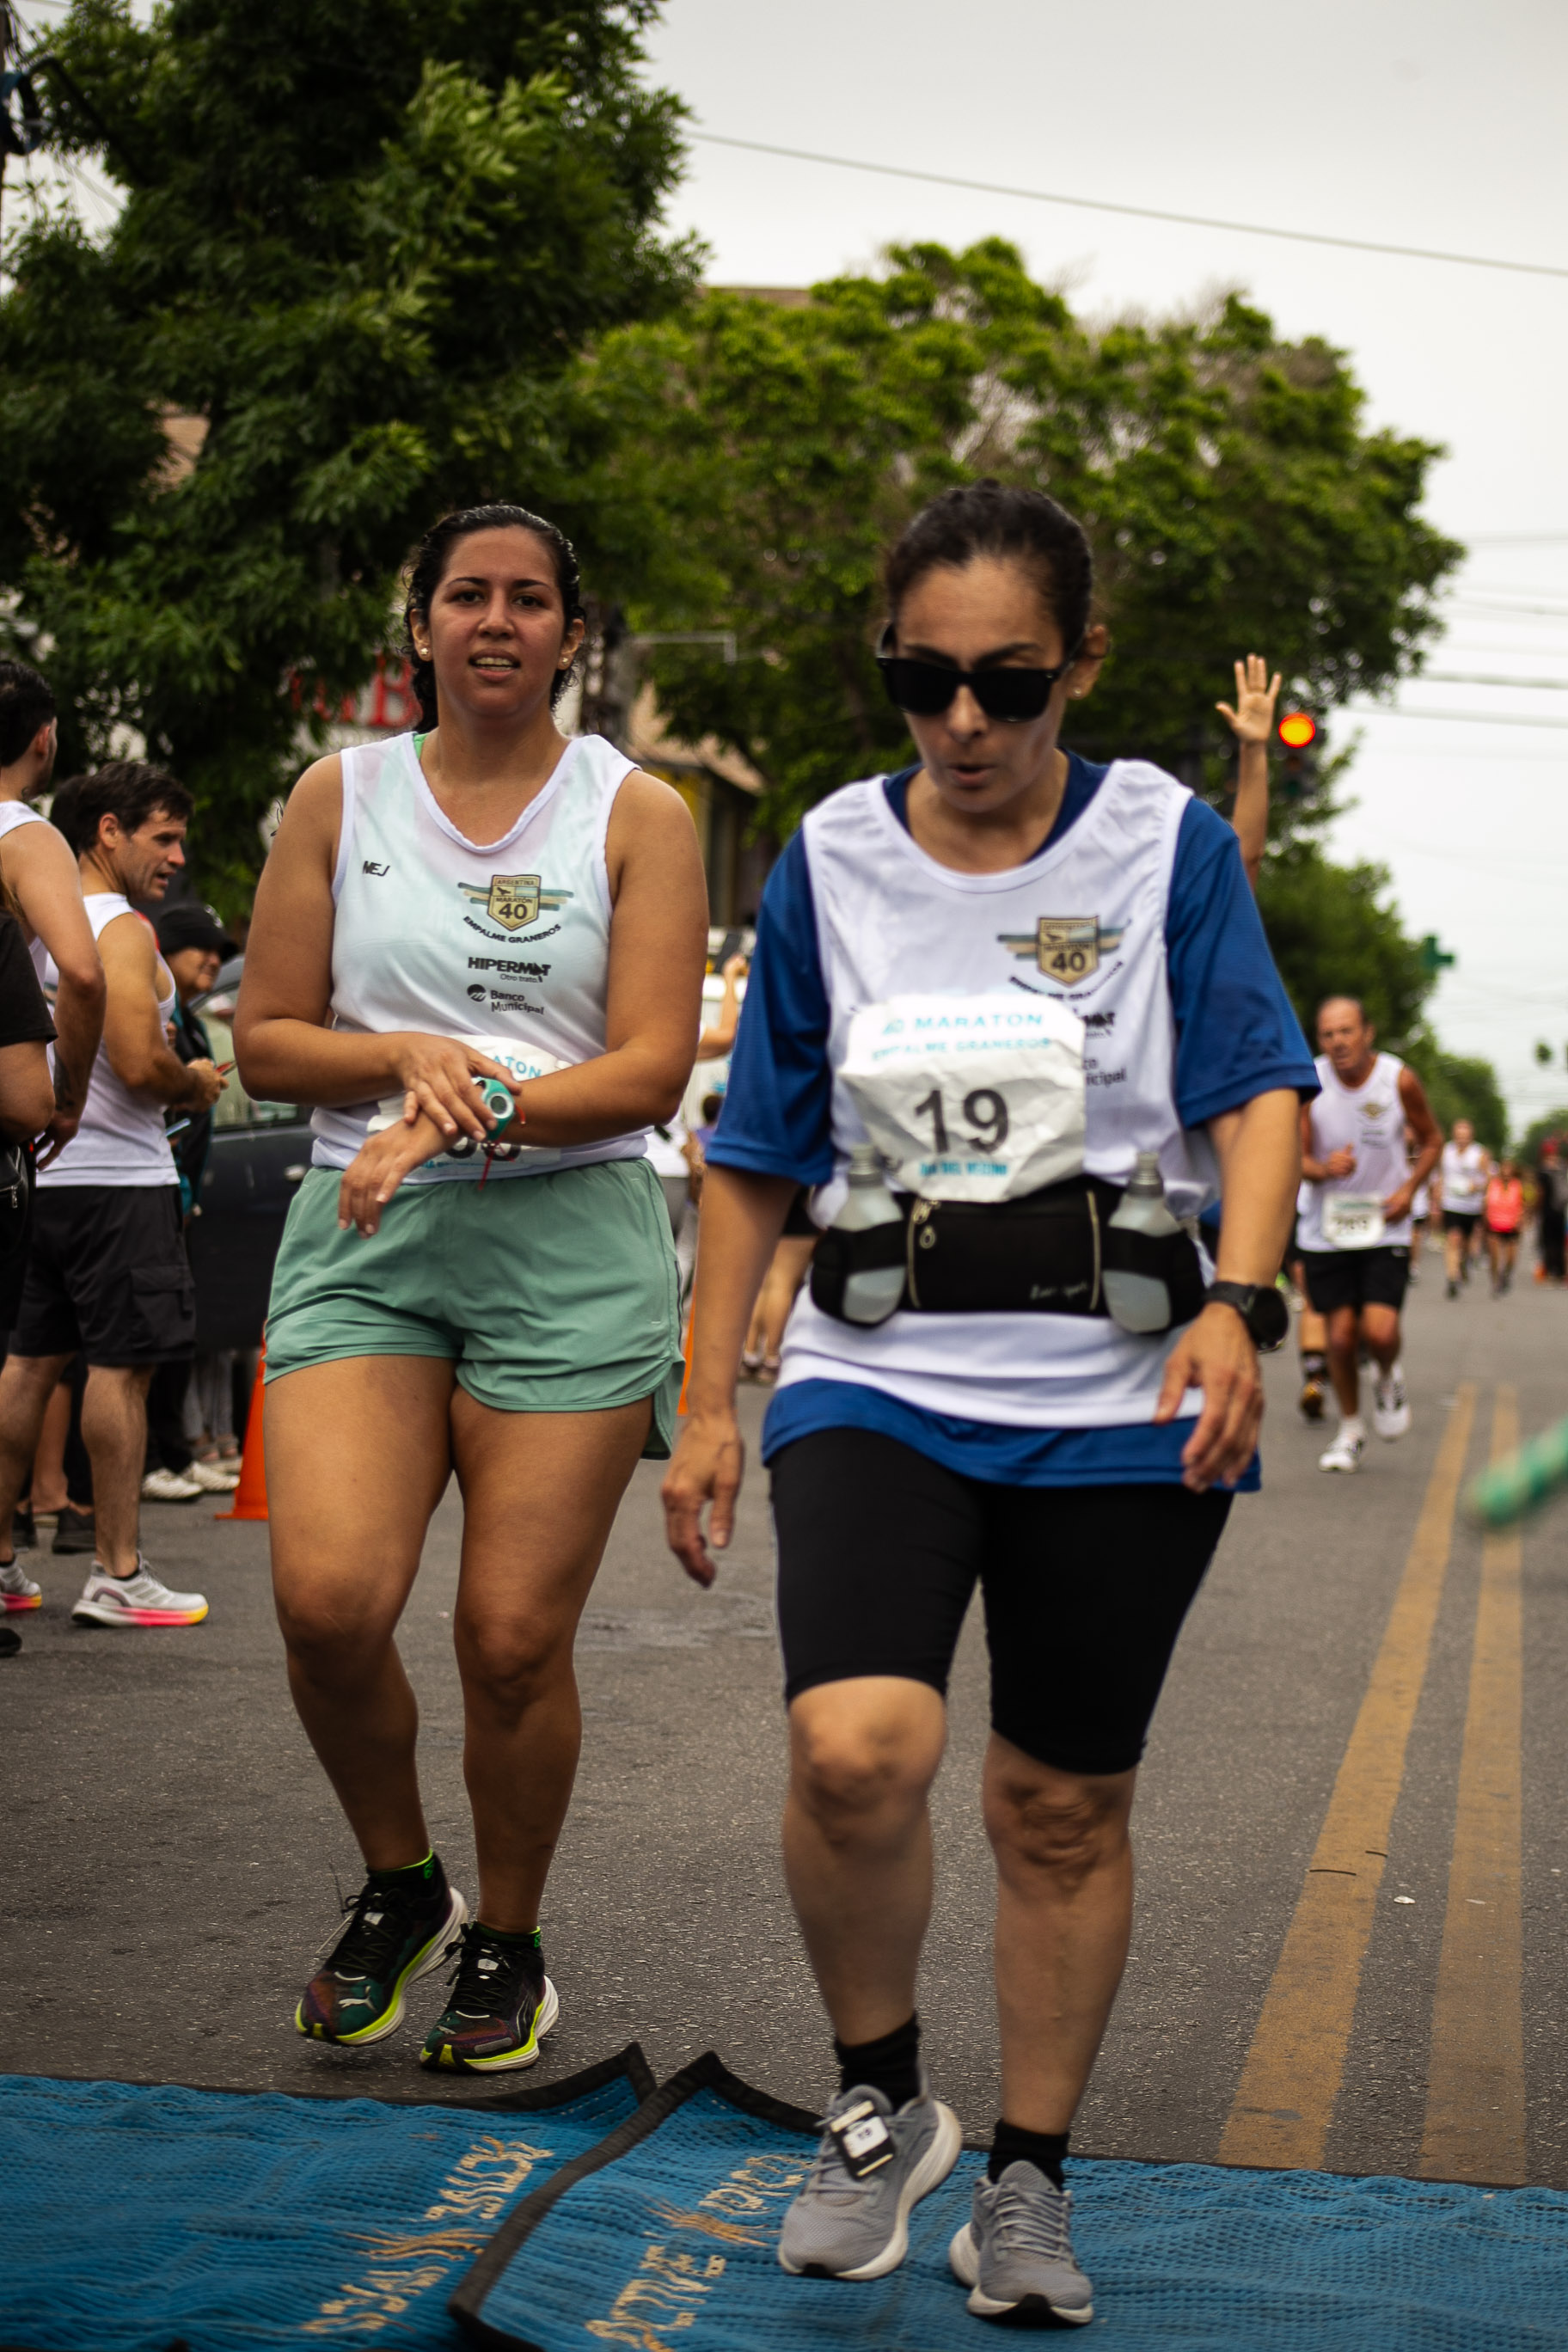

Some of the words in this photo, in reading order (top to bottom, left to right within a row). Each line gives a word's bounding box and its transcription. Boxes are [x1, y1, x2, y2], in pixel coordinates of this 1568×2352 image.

[498, 903, 528, 920] 40
[463, 916, 506, 943] EMPALME
[508, 923, 561, 943] GRANEROS
[1051, 951, 1086, 973] 40
[499, 973, 518, 982] Otro
[490, 989, 525, 1002] Banco
[491, 1001, 544, 1014] Municipal
[915, 1014, 1043, 1030] MARATON
[914, 1087, 1010, 1155] 19
